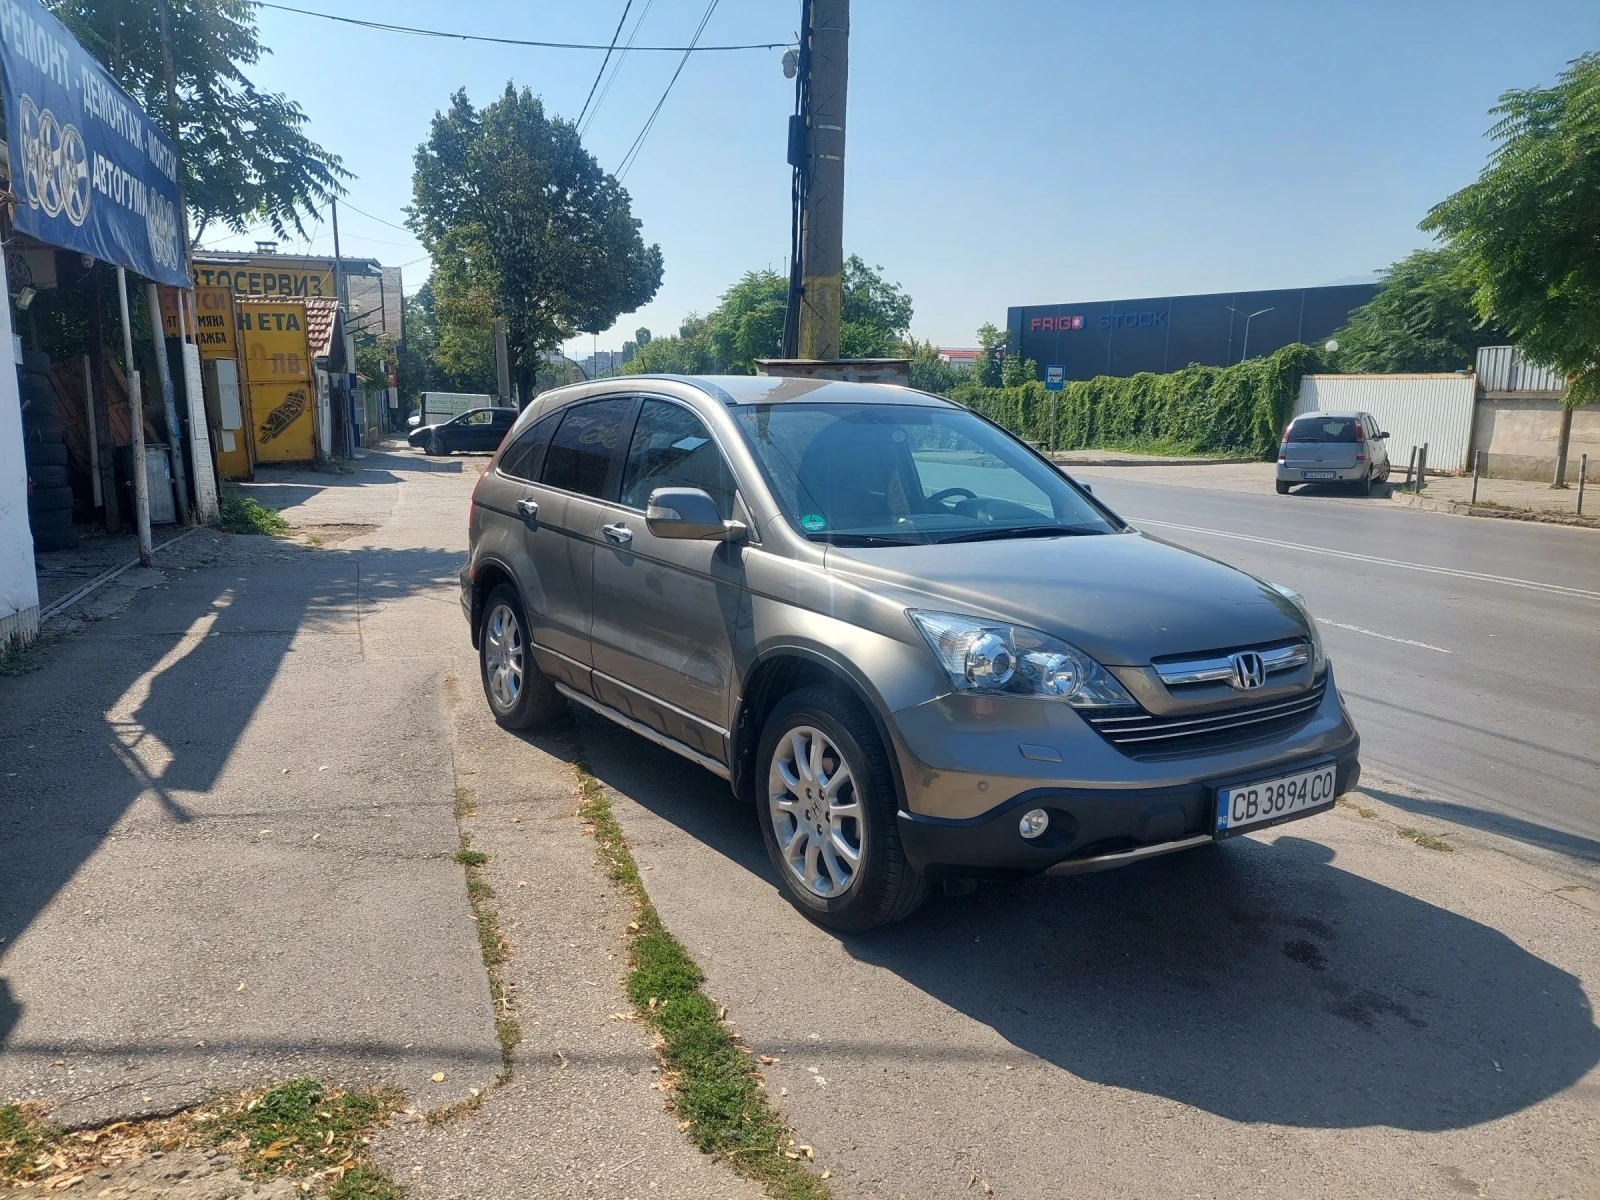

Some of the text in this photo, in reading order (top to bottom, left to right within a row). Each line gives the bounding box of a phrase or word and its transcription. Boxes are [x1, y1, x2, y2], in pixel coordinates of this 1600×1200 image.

[0, 0, 70, 91] РЕМОНТ
[81, 63, 144, 154] ДЕМОНТАЖ
[148, 129, 177, 184] МОНТАЖ
[92, 149, 148, 218] АВТОГУМИ
[1030, 312, 1168, 332] FRIGO STOCK
[1217, 816, 1228, 826] BG
